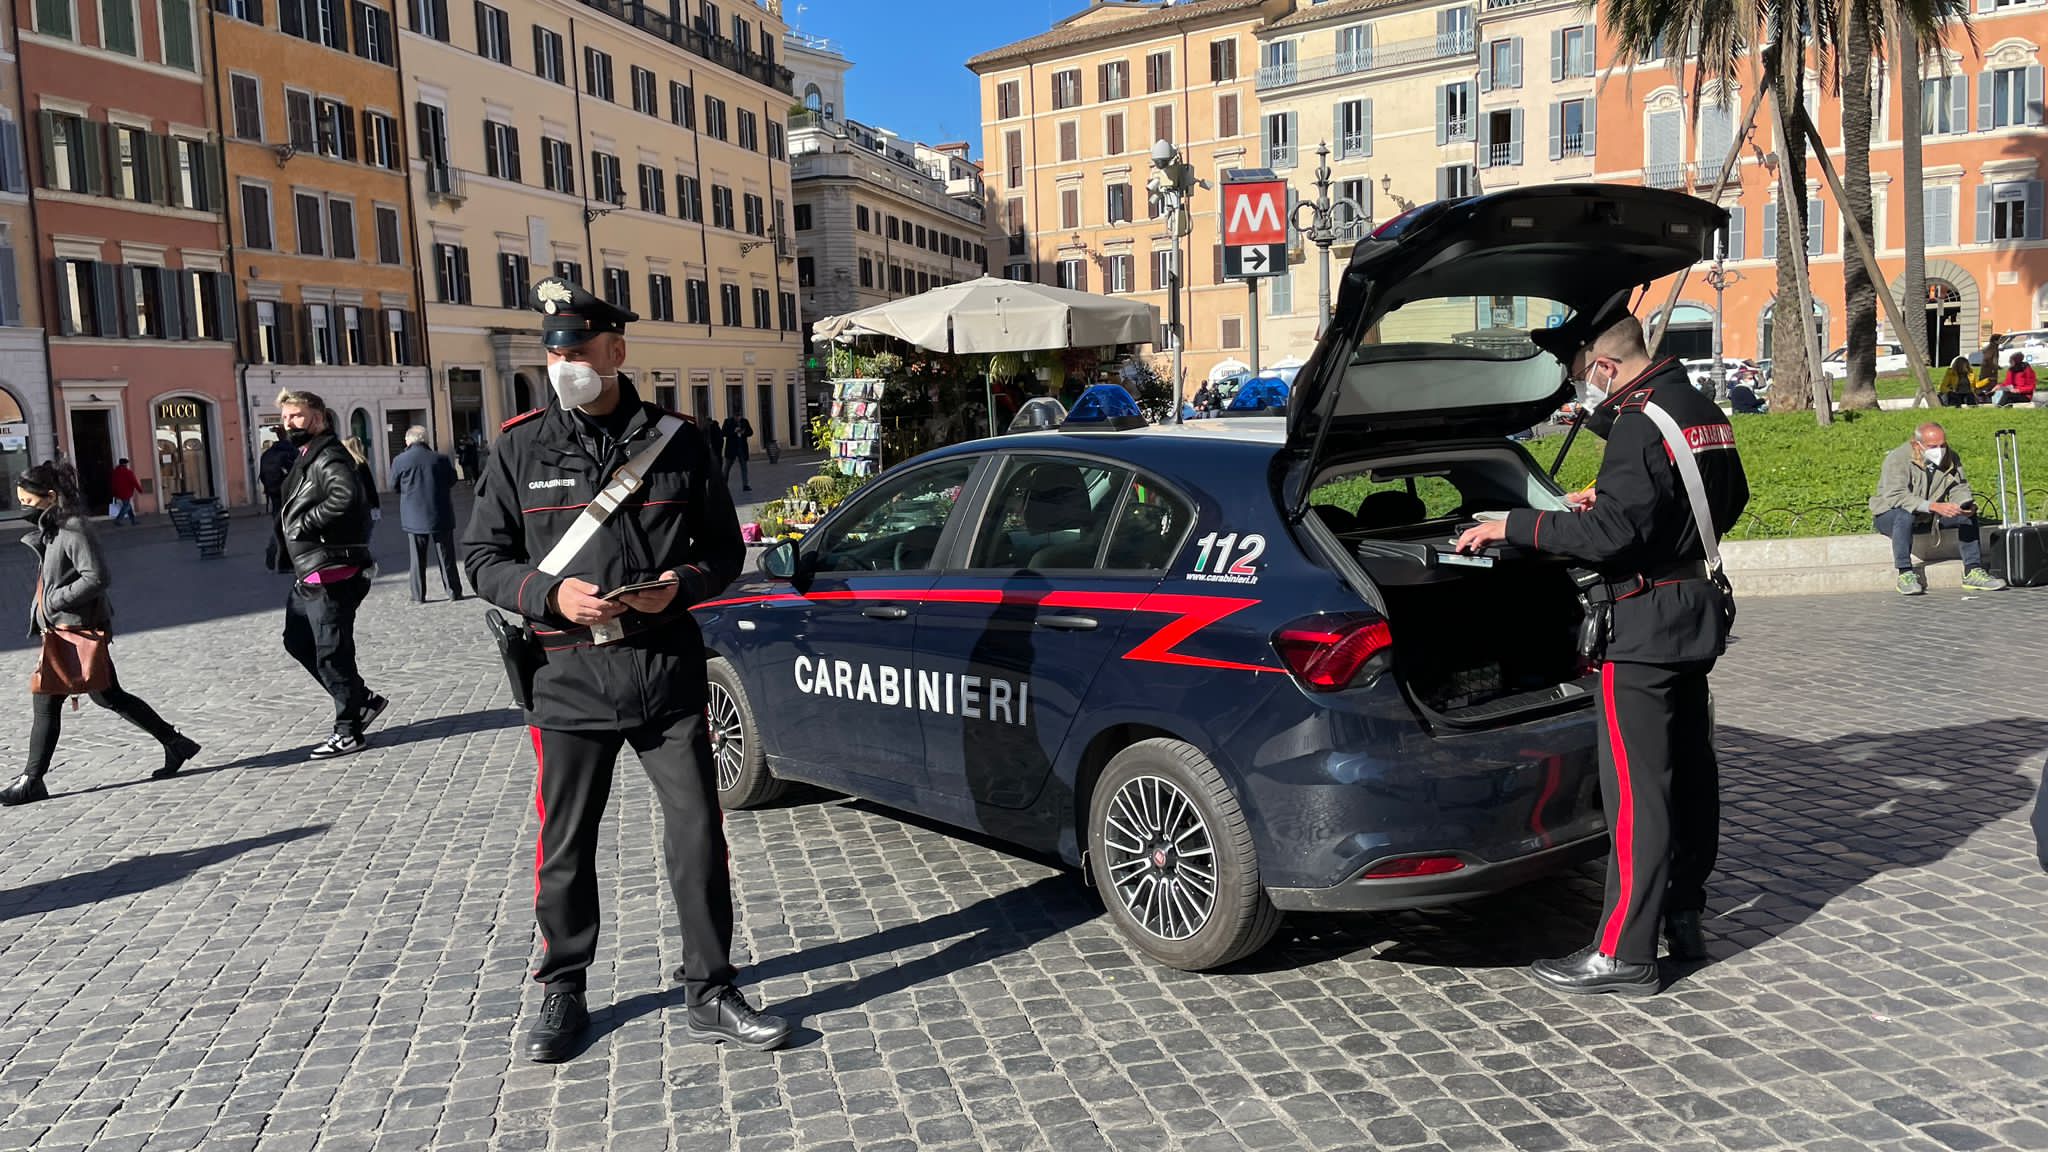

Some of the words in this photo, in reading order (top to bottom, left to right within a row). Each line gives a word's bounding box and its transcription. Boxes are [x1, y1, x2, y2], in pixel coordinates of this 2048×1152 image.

[1229, 193, 1281, 232] M
[162, 403, 196, 418] PUCCI
[528, 478, 576, 489] CARABINIERI
[1193, 532, 1266, 575] 112
[1186, 573, 1259, 584] www.carabinieri.it
[795, 655, 1029, 726] CARABINIERI
